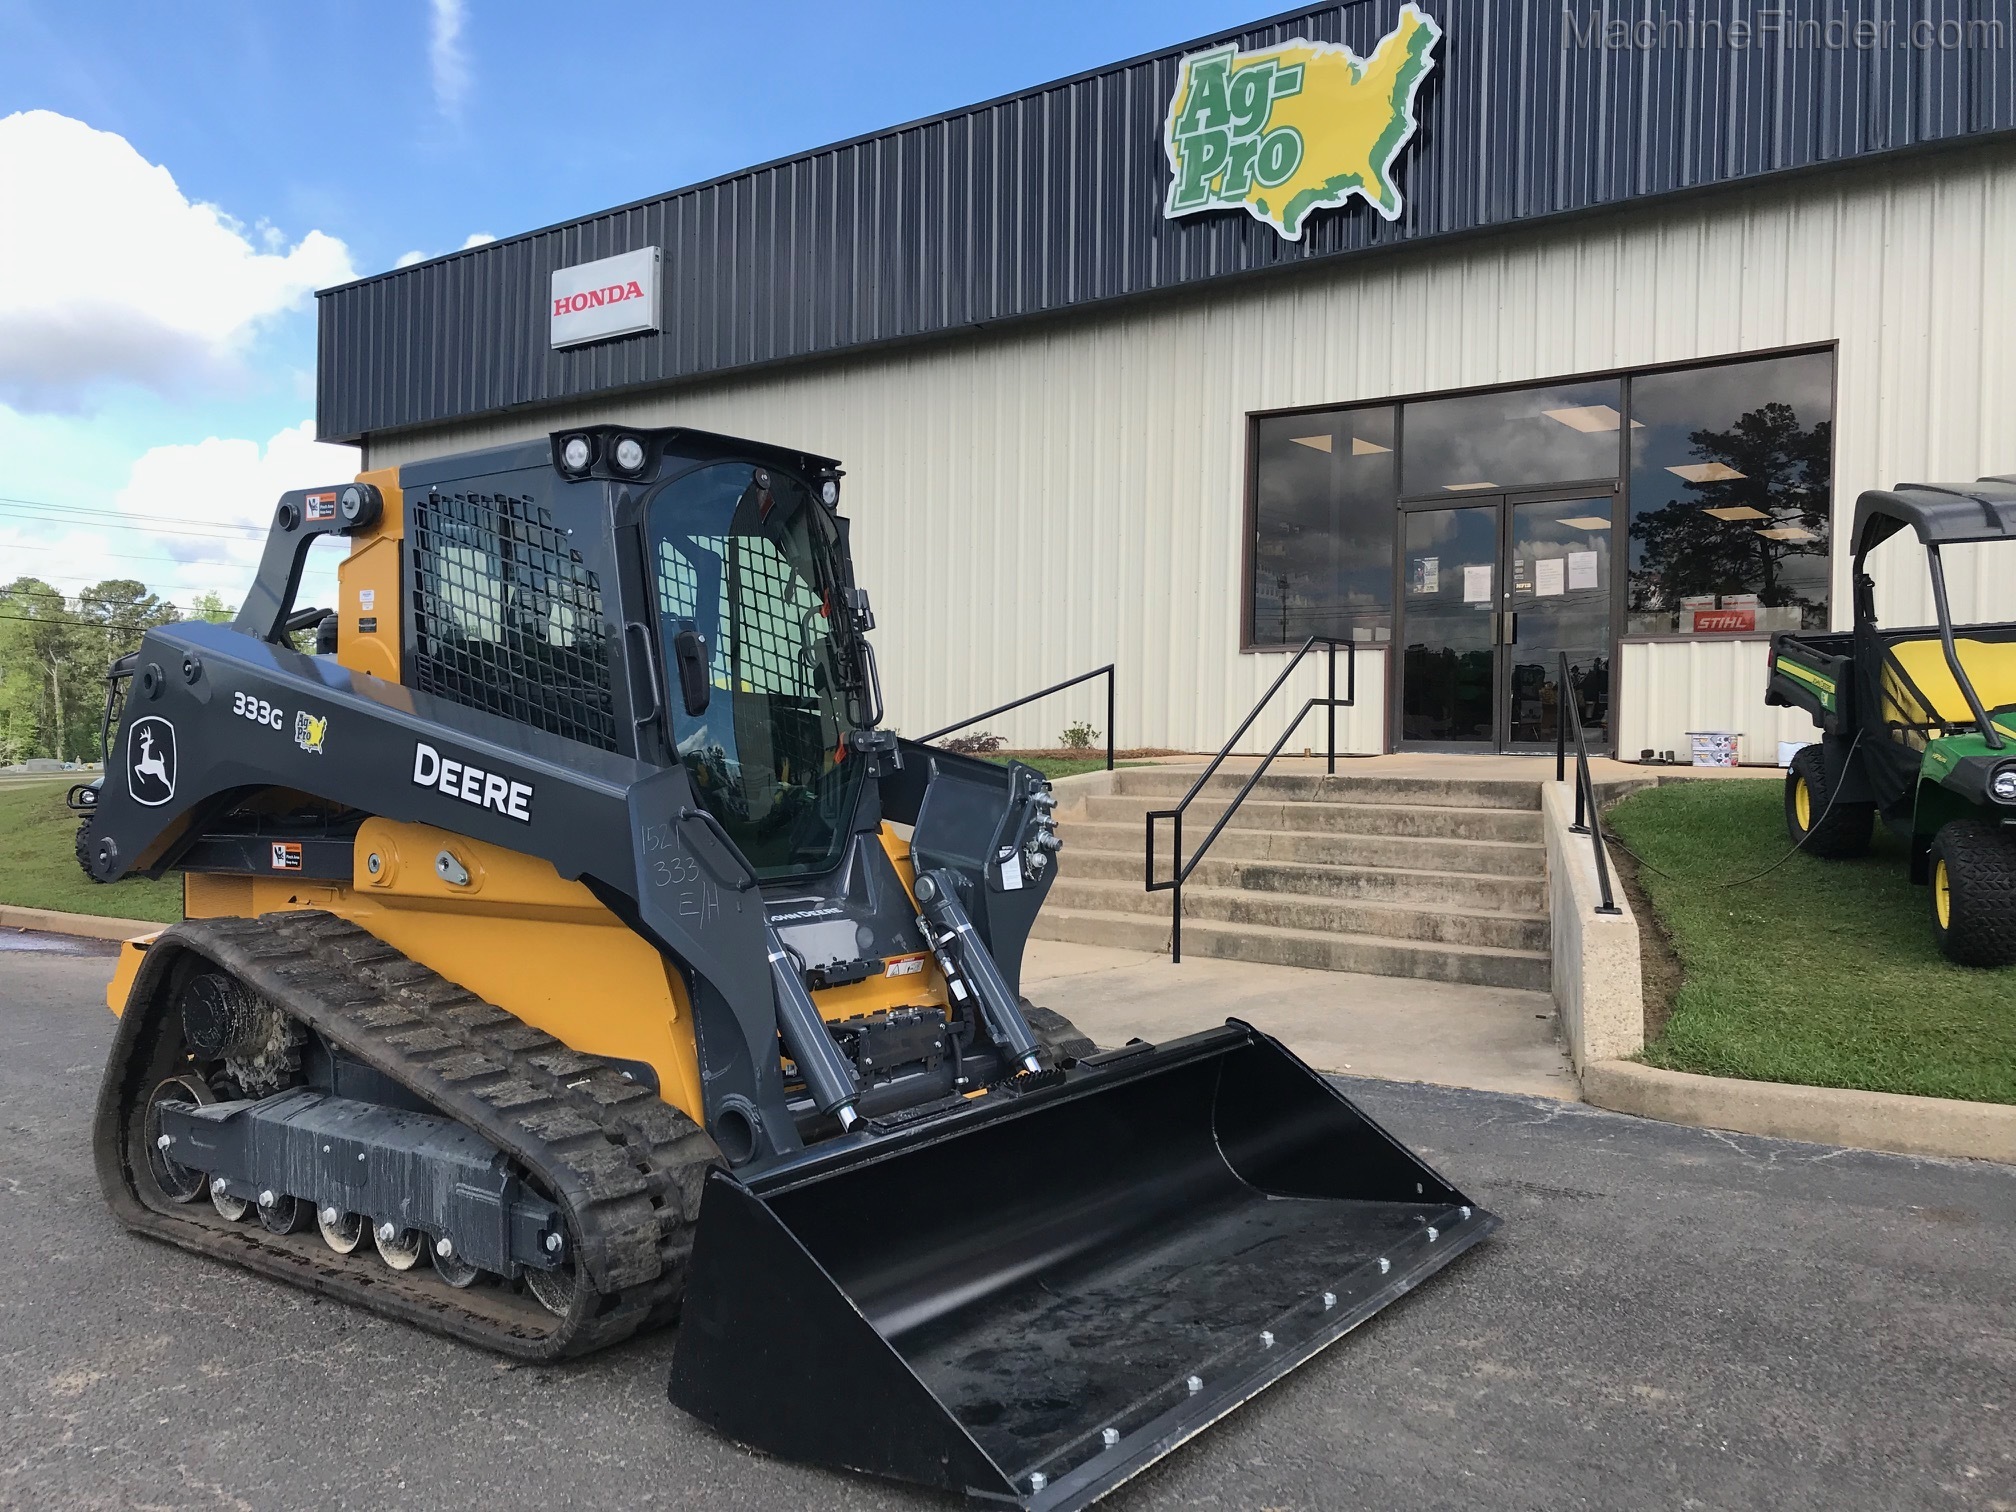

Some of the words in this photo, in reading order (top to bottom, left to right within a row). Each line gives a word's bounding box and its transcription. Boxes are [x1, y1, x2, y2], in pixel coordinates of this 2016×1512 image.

[1174, 52, 1305, 140] Ag-
[1172, 128, 1303, 209] Pro
[554, 281, 644, 316] HONDA
[1697, 617, 1747, 629] STIHL
[233, 691, 283, 730] 333G
[413, 742, 533, 821] DEERE
[653, 857, 700, 887] 333
[797, 907, 843, 918] DEERE
